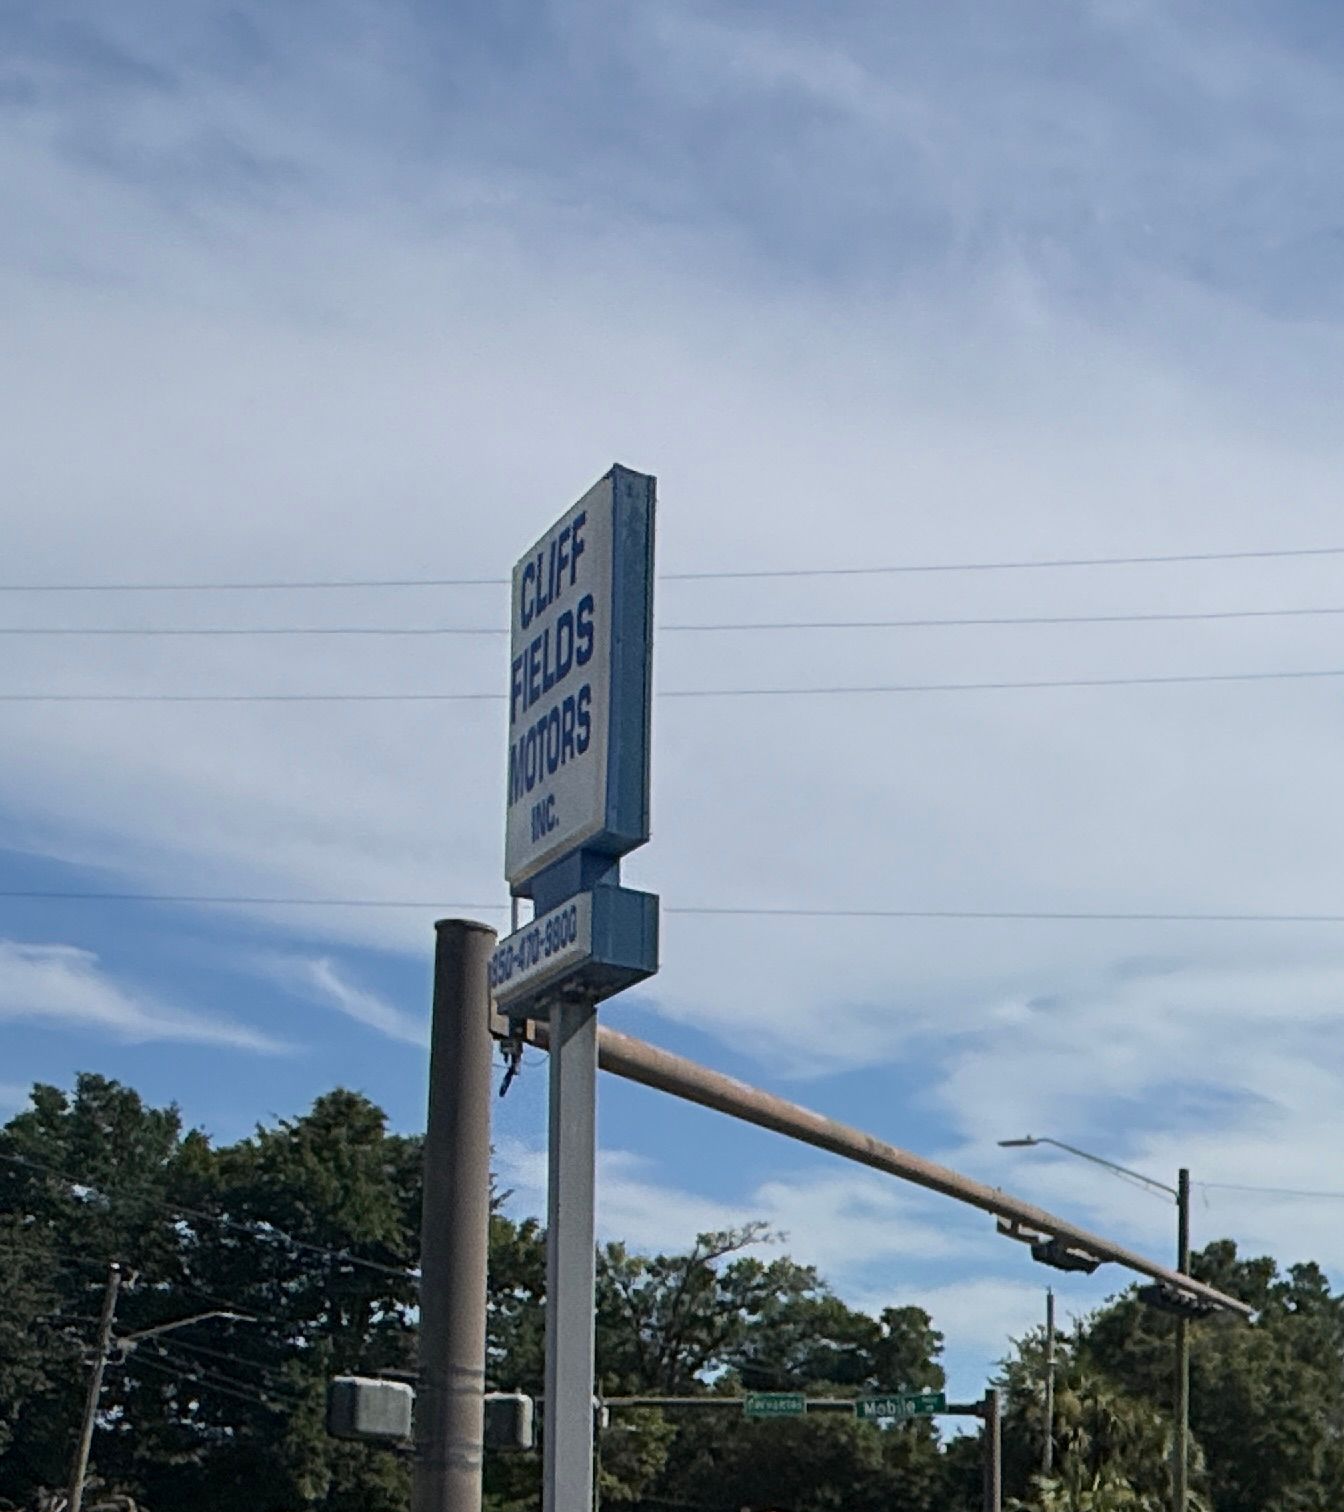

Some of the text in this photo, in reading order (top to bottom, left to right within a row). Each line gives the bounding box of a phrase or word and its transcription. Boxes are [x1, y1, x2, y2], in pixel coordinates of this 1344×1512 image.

[521, 511, 587, 630] CLIFF
[511, 593, 595, 725] FIELDS
[509, 683, 592, 808] MOTORS
[531, 794, 560, 844] INC.
